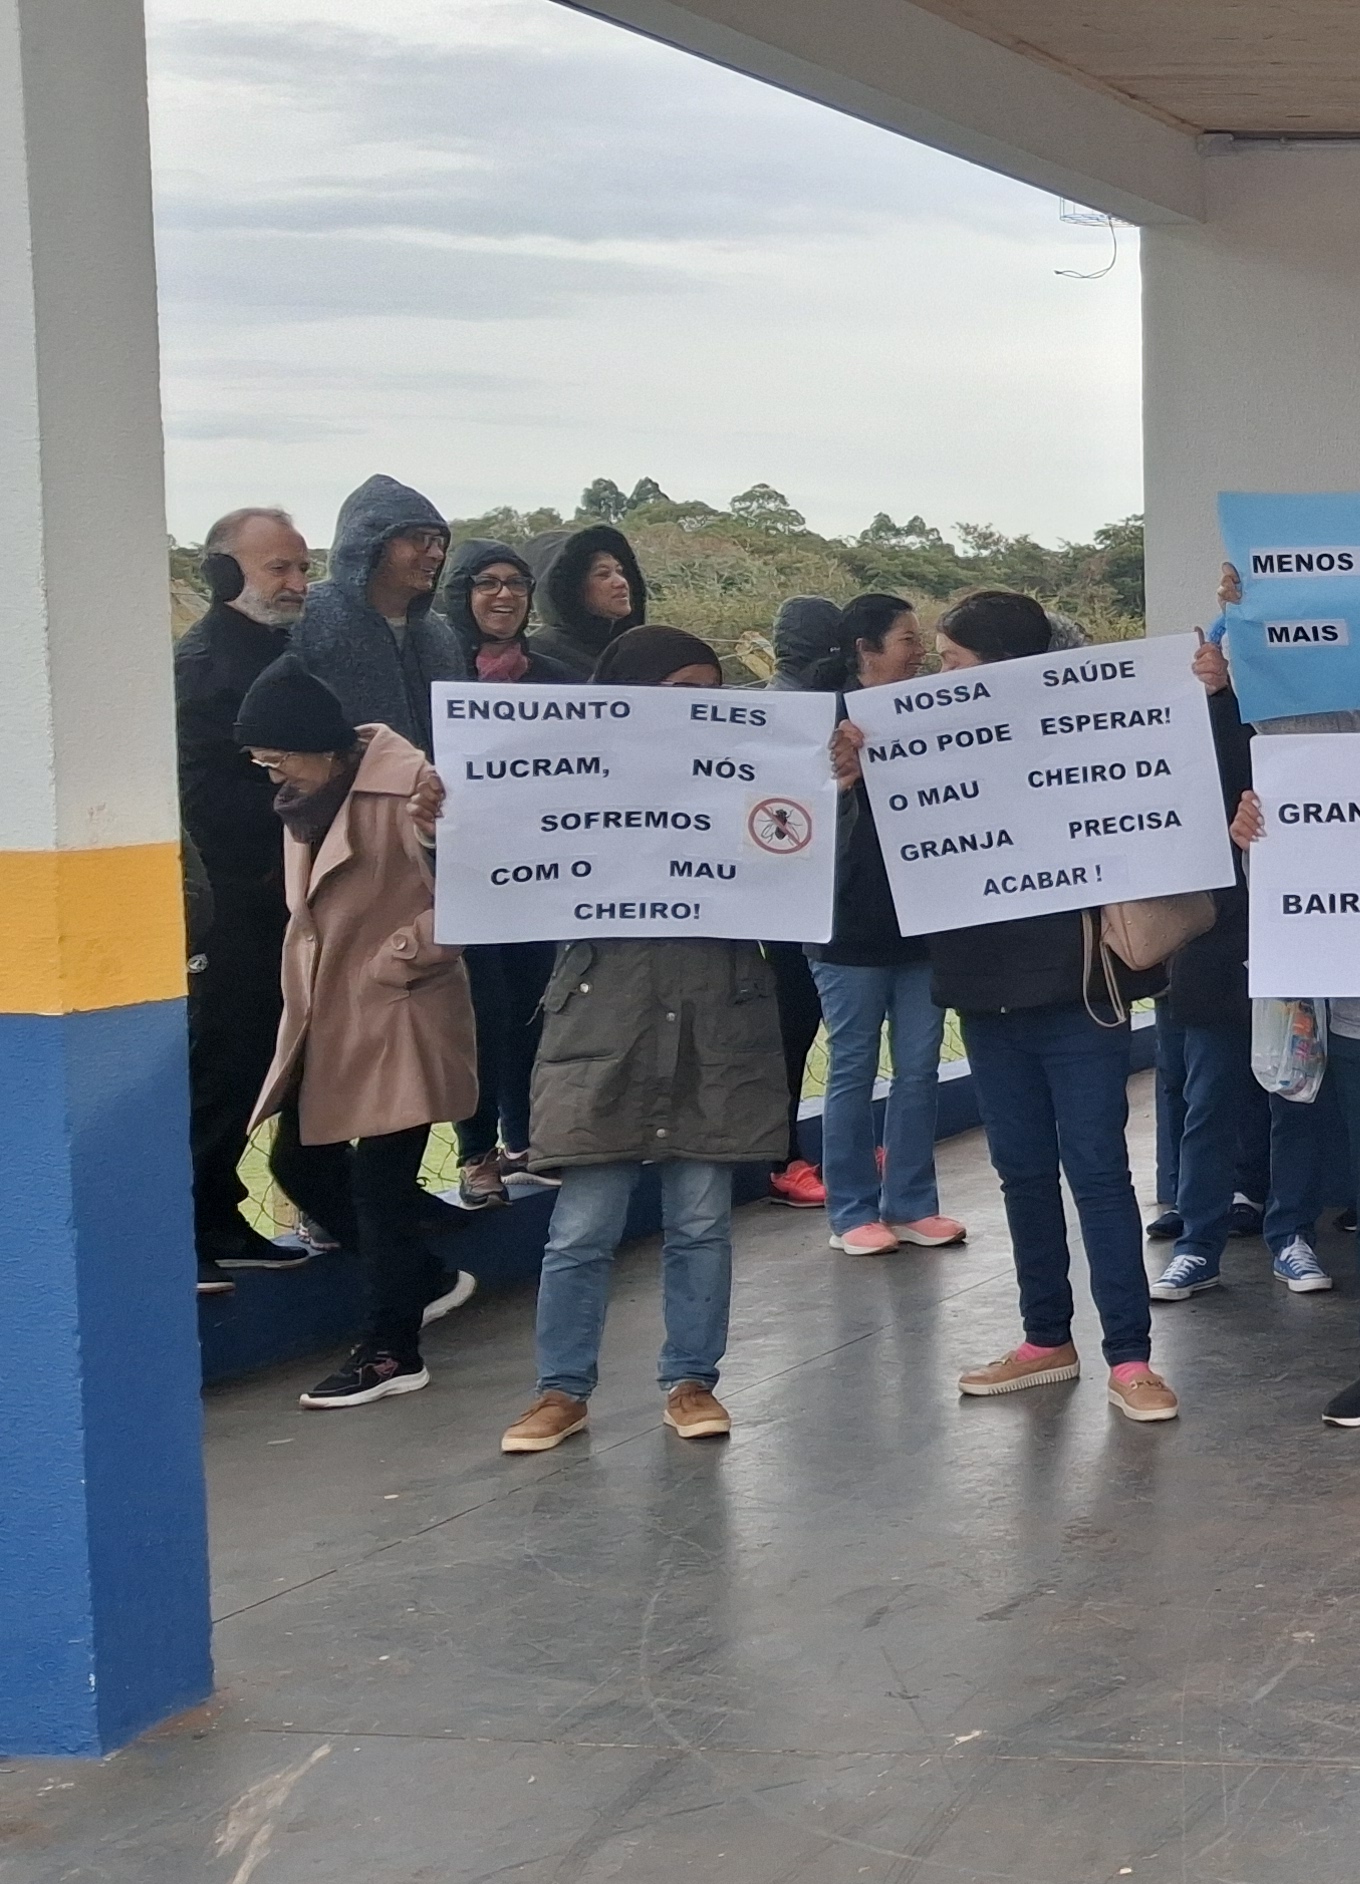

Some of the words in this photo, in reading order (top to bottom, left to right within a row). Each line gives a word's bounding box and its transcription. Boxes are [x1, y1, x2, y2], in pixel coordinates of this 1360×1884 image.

[1252, 552, 1354, 574] MENOS
[1267, 625, 1339, 643] MAIS
[894, 682, 991, 714] NOSSA
[1042, 660, 1136, 687] SAÚDE
[447, 699, 631, 721] ENQUANTO
[690, 703, 767, 727] ELES
[867, 739, 928, 763] NÃO
[937, 723, 1012, 751] PODE
[1040, 707, 1170, 736] ESPERAR!
[466, 756, 610, 780] LUCRAM,
[692, 757, 755, 782] NÓS
[889, 794, 908, 811] O
[917, 780, 980, 807] MAU
[1027, 762, 1126, 788] CHEIRO
[1136, 758, 1171, 778] DA
[541, 811, 711, 832] SOFREMOS
[900, 829, 1014, 862] GRANJA
[1068, 810, 1182, 839] PRECISA
[491, 862, 559, 886] COM
[571, 860, 592, 878] O
[670, 860, 736, 880] MAU
[983, 867, 1088, 896] ACABAR
[574, 902, 700, 920] CHEIRO!
